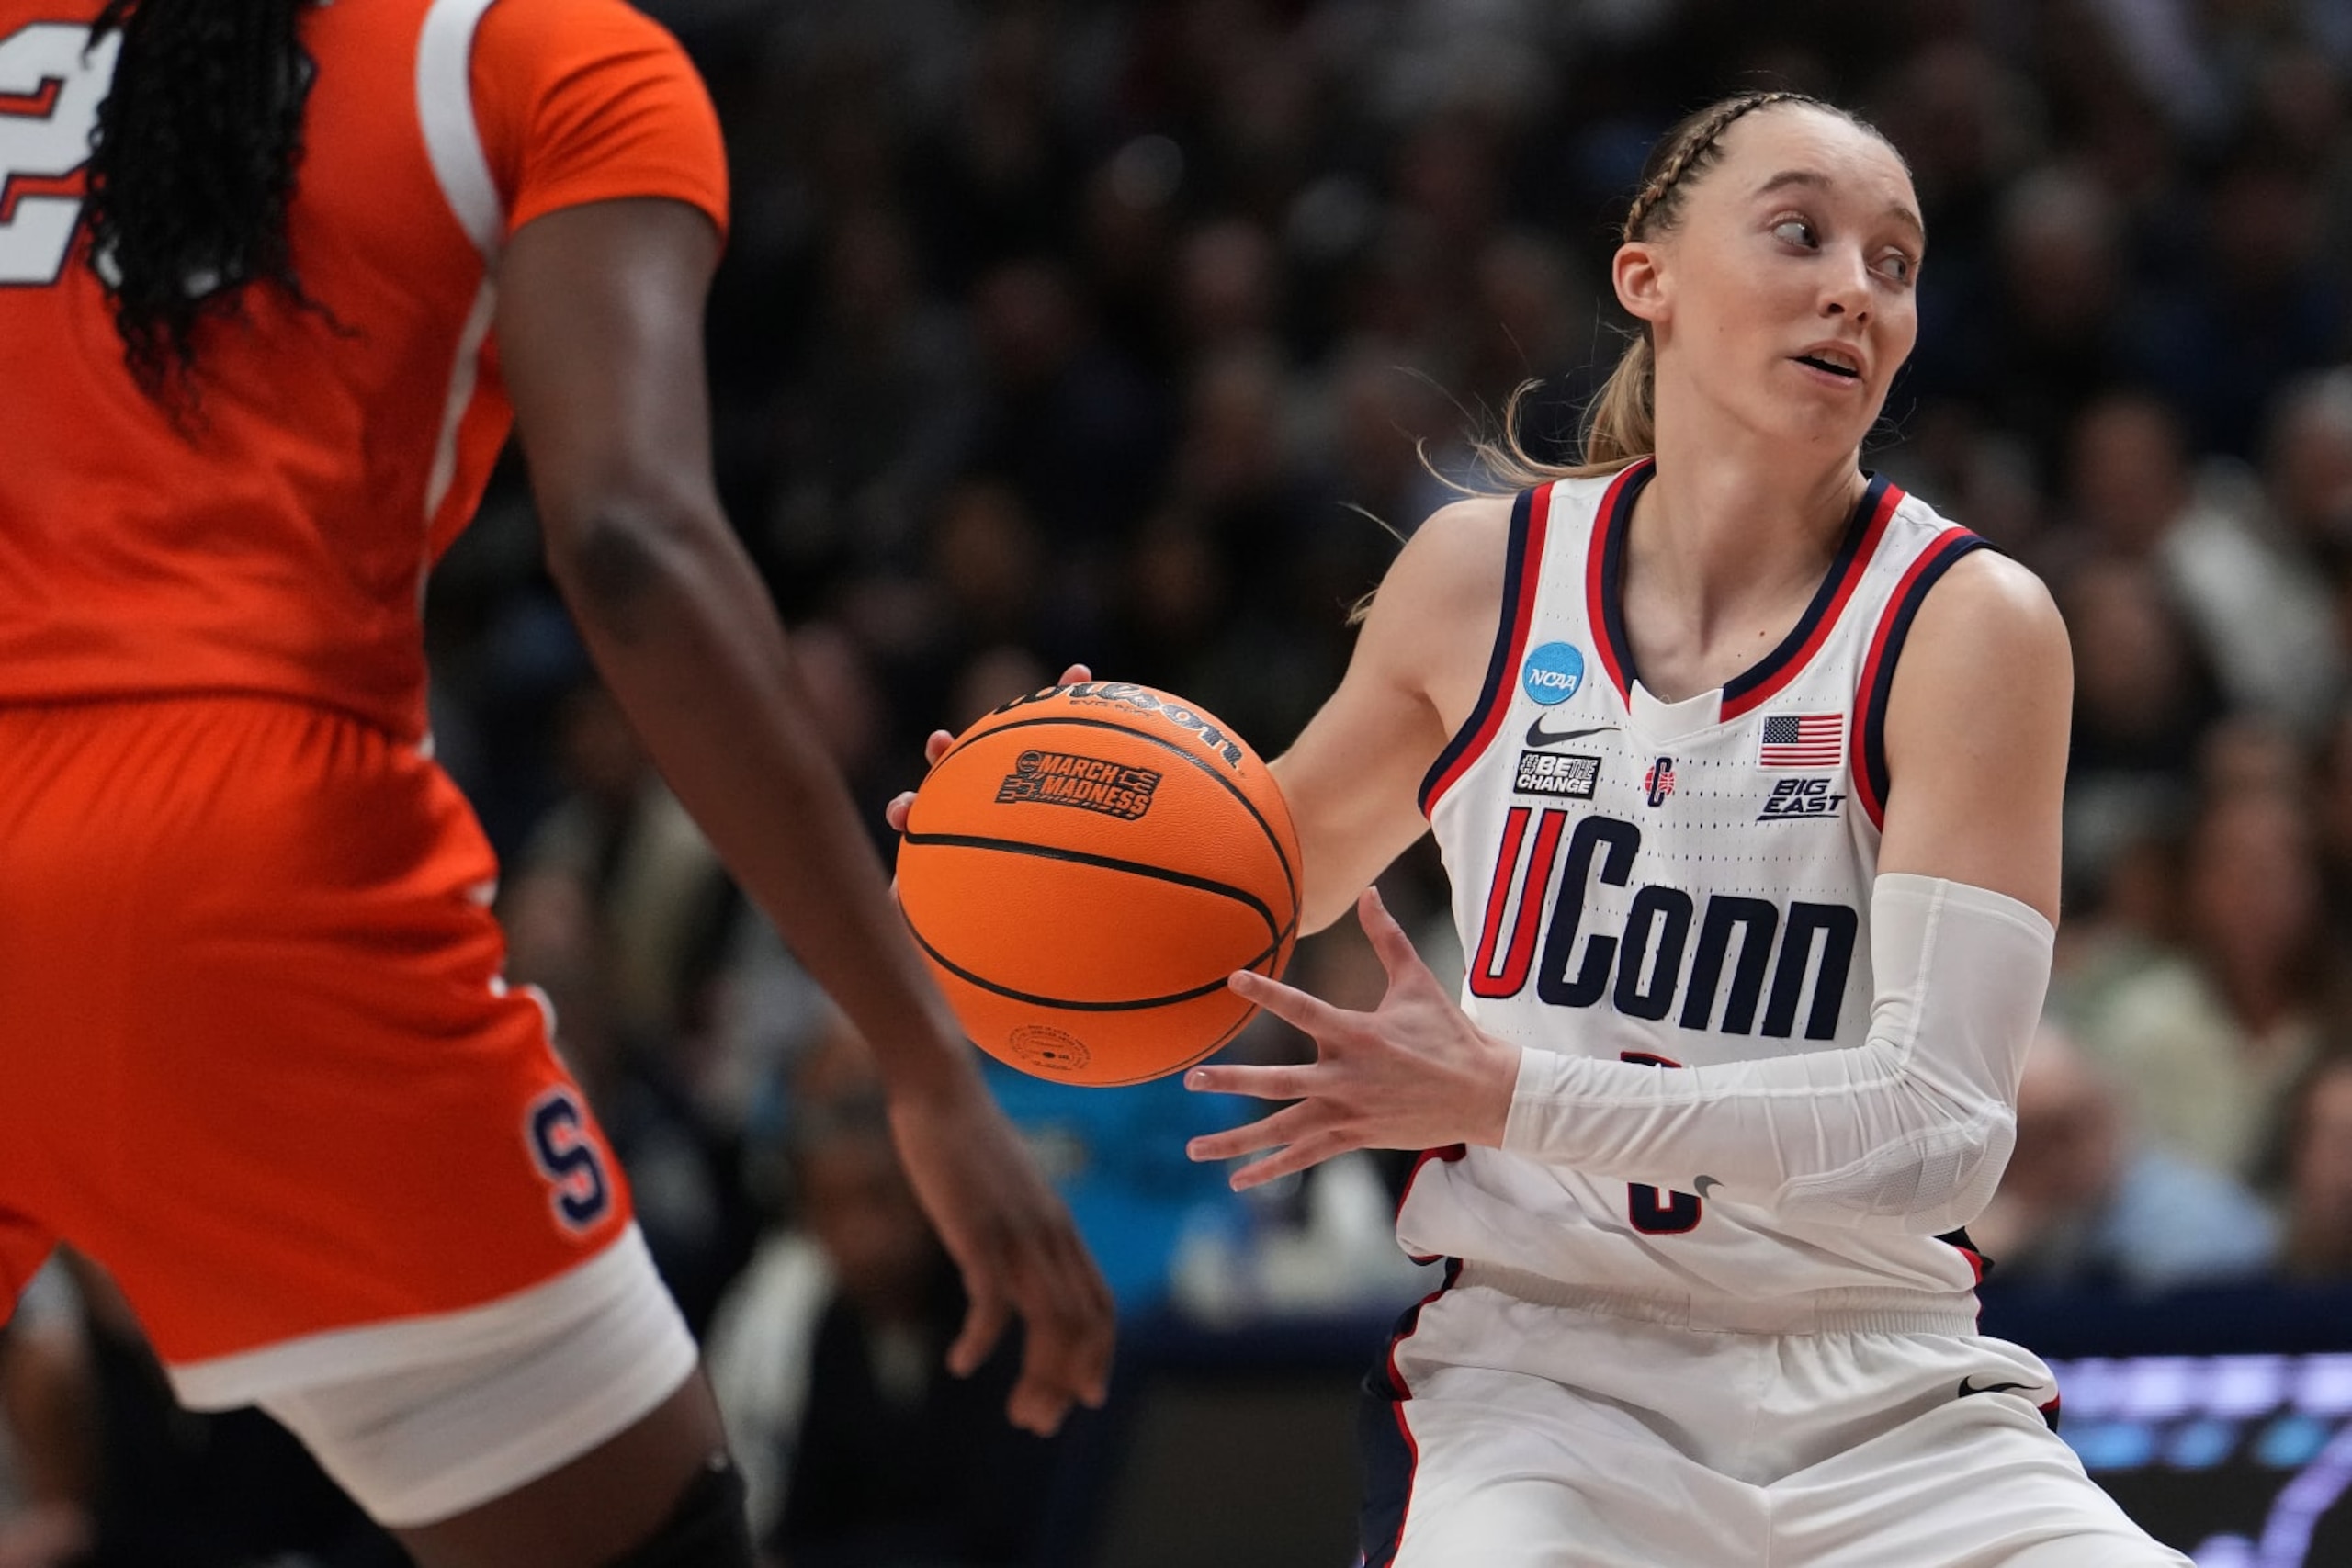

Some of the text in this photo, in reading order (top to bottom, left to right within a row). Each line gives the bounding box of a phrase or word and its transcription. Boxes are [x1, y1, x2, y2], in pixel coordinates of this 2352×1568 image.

[1528, 668, 1577, 691] NCAA
[1038, 754, 1120, 784] MARCH
[1040, 775, 1149, 815] MADNESS
[1516, 773, 1593, 795] CHANGE
[1772, 778, 1832, 796] BIG
[1762, 795, 1847, 813] EAST
[1470, 806, 1859, 1041] UConn
[528, 1088, 612, 1228] S
